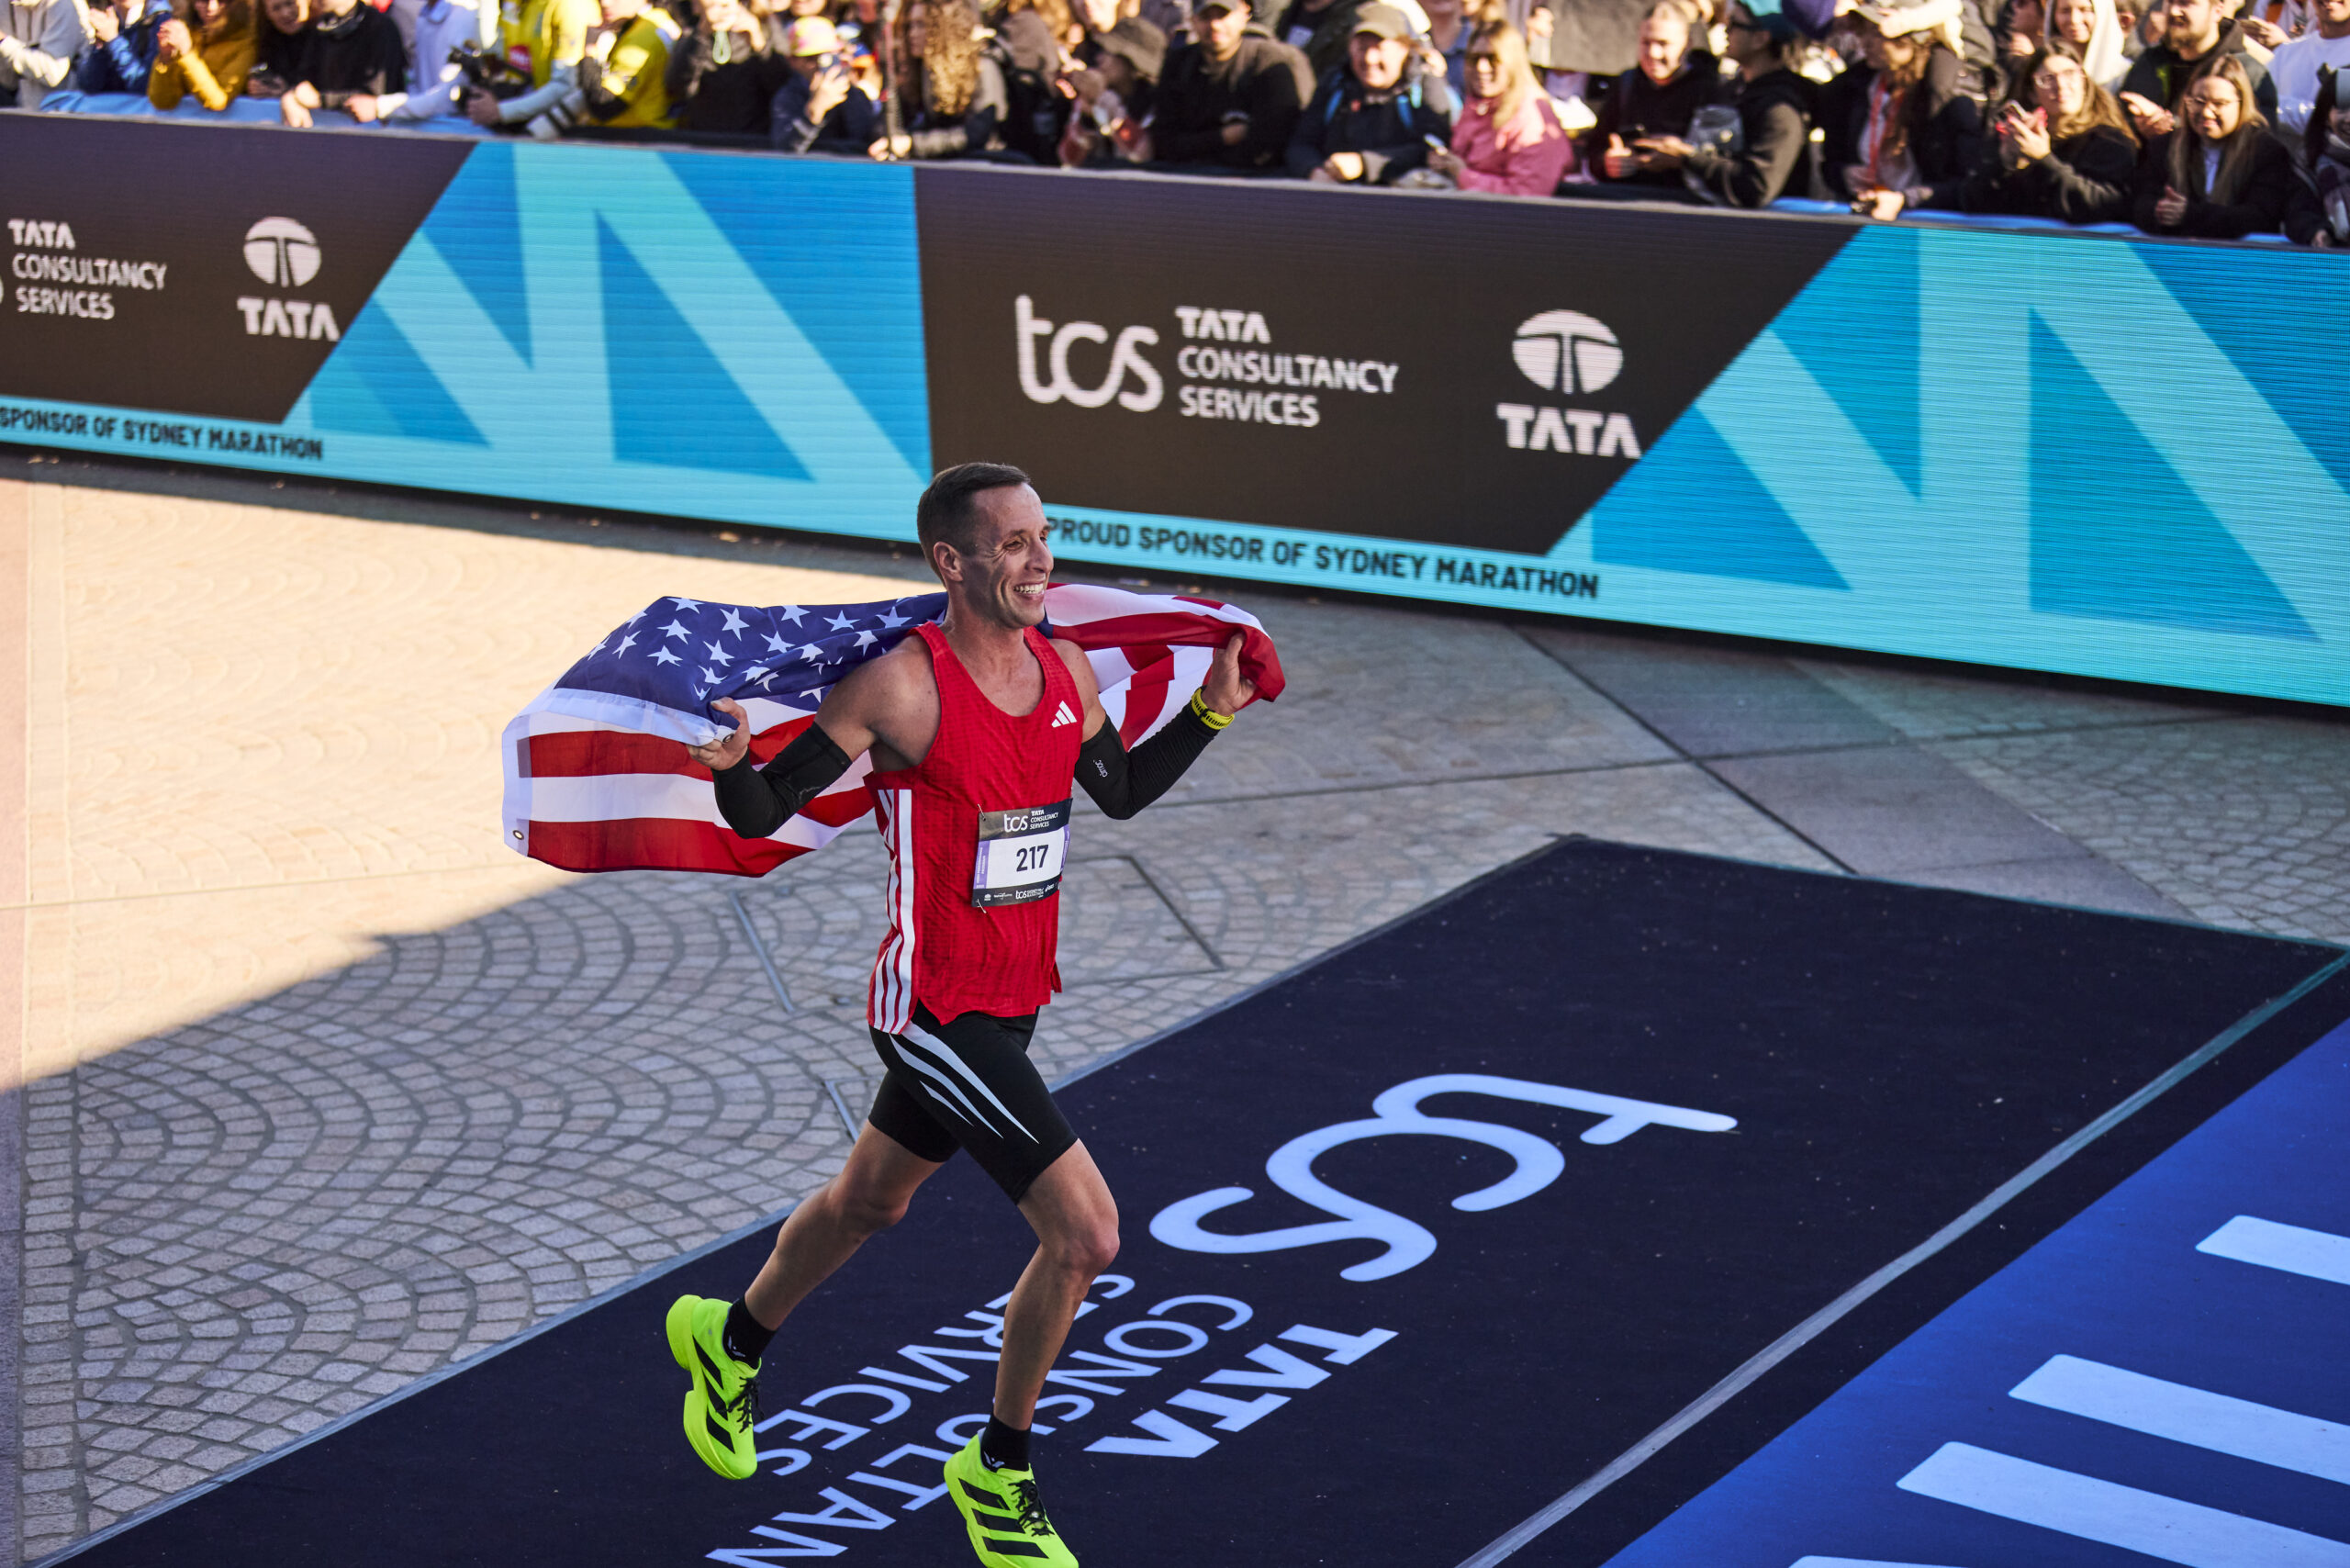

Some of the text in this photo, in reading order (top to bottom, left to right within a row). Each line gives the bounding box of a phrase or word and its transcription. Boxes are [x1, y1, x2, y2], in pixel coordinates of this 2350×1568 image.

[8, 218, 75, 250] TATA
[13, 252, 167, 290] CONSULTANCY
[17, 286, 115, 320] SERVICES
[238, 297, 341, 342] TATA
[1175, 307, 1270, 343] TATA
[1015, 295, 1163, 412] tcs
[1178, 346, 1399, 394] CONSULTANCY
[1180, 386, 1320, 428] SERVICES
[0, 406, 323, 461] SPONSOR OF SYDNEY MARATHON
[1496, 404, 1641, 458] TATA
[1138, 526, 1265, 561] SPONSOR
[1272, 541, 1308, 566] OF
[1315, 545, 1427, 579] SYDNEY
[1436, 558, 1600, 599] MARATHON
[1003, 813, 1029, 833] tcs
[1029, 821, 1049, 830] SERVICES
[1030, 812, 1059, 823] CONSULTANCY
[1016, 844, 1049, 872] 217
[1149, 1074, 1738, 1282] tcs
[1083, 1324, 1399, 1458] TATA
